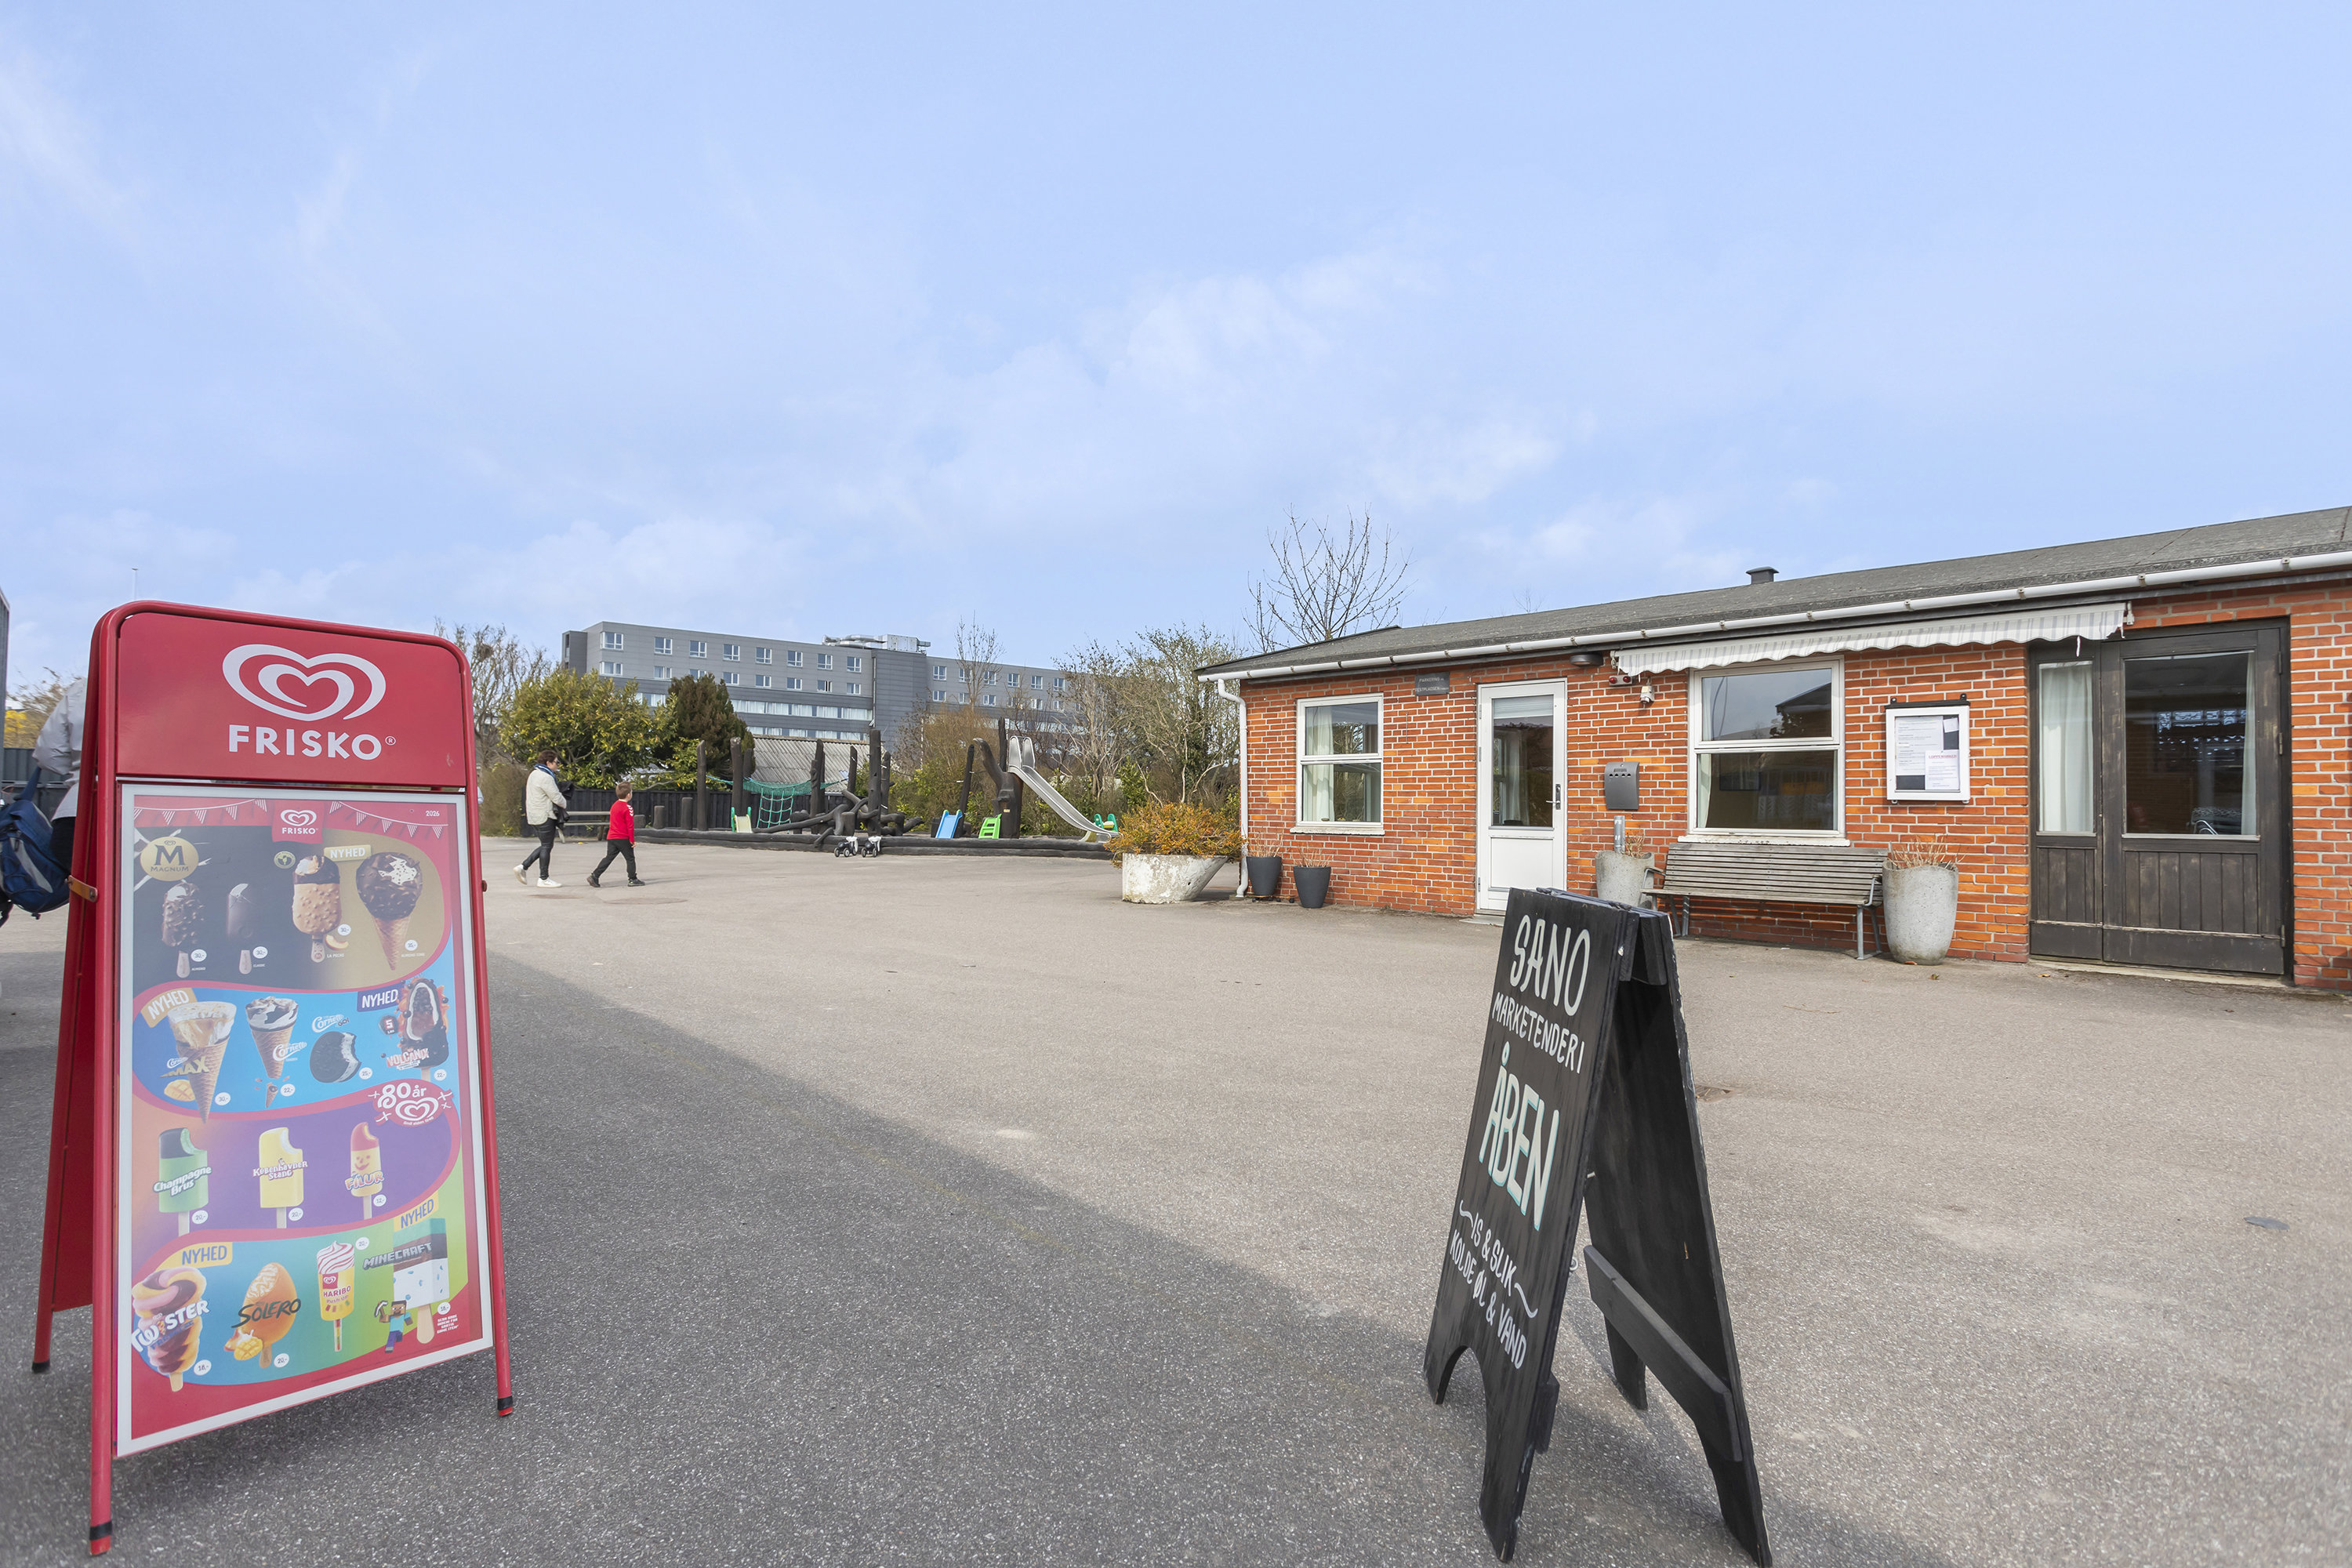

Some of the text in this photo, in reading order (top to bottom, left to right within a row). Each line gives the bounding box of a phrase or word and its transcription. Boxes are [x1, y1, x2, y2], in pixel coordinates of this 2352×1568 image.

[330, 848, 366, 859] NYHED
[1509, 914, 1591, 1016] SANO
[147, 989, 190, 1020] NYHED
[361, 989, 399, 1008] NYHED
[385, 1018, 394, 1029] 5
[1492, 991, 1584, 1074] MARKETENDERI
[377, 1082, 427, 1109] 80 år
[1479, 1041, 1559, 1231] ÅBEN
[153, 1167, 212, 1192] Champagne
[170, 1179, 195, 1196] Brus
[401, 1199, 434, 1229] NYHED
[182, 1245, 227, 1265] NYHED
[362, 1243, 432, 1270] MINECRAFT
[1471, 1212, 1517, 1297] IS & SLIK
[323, 1286, 351, 1297] HARIBO
[1450, 1229, 1527, 1370] KOLDE ØL & VAND
